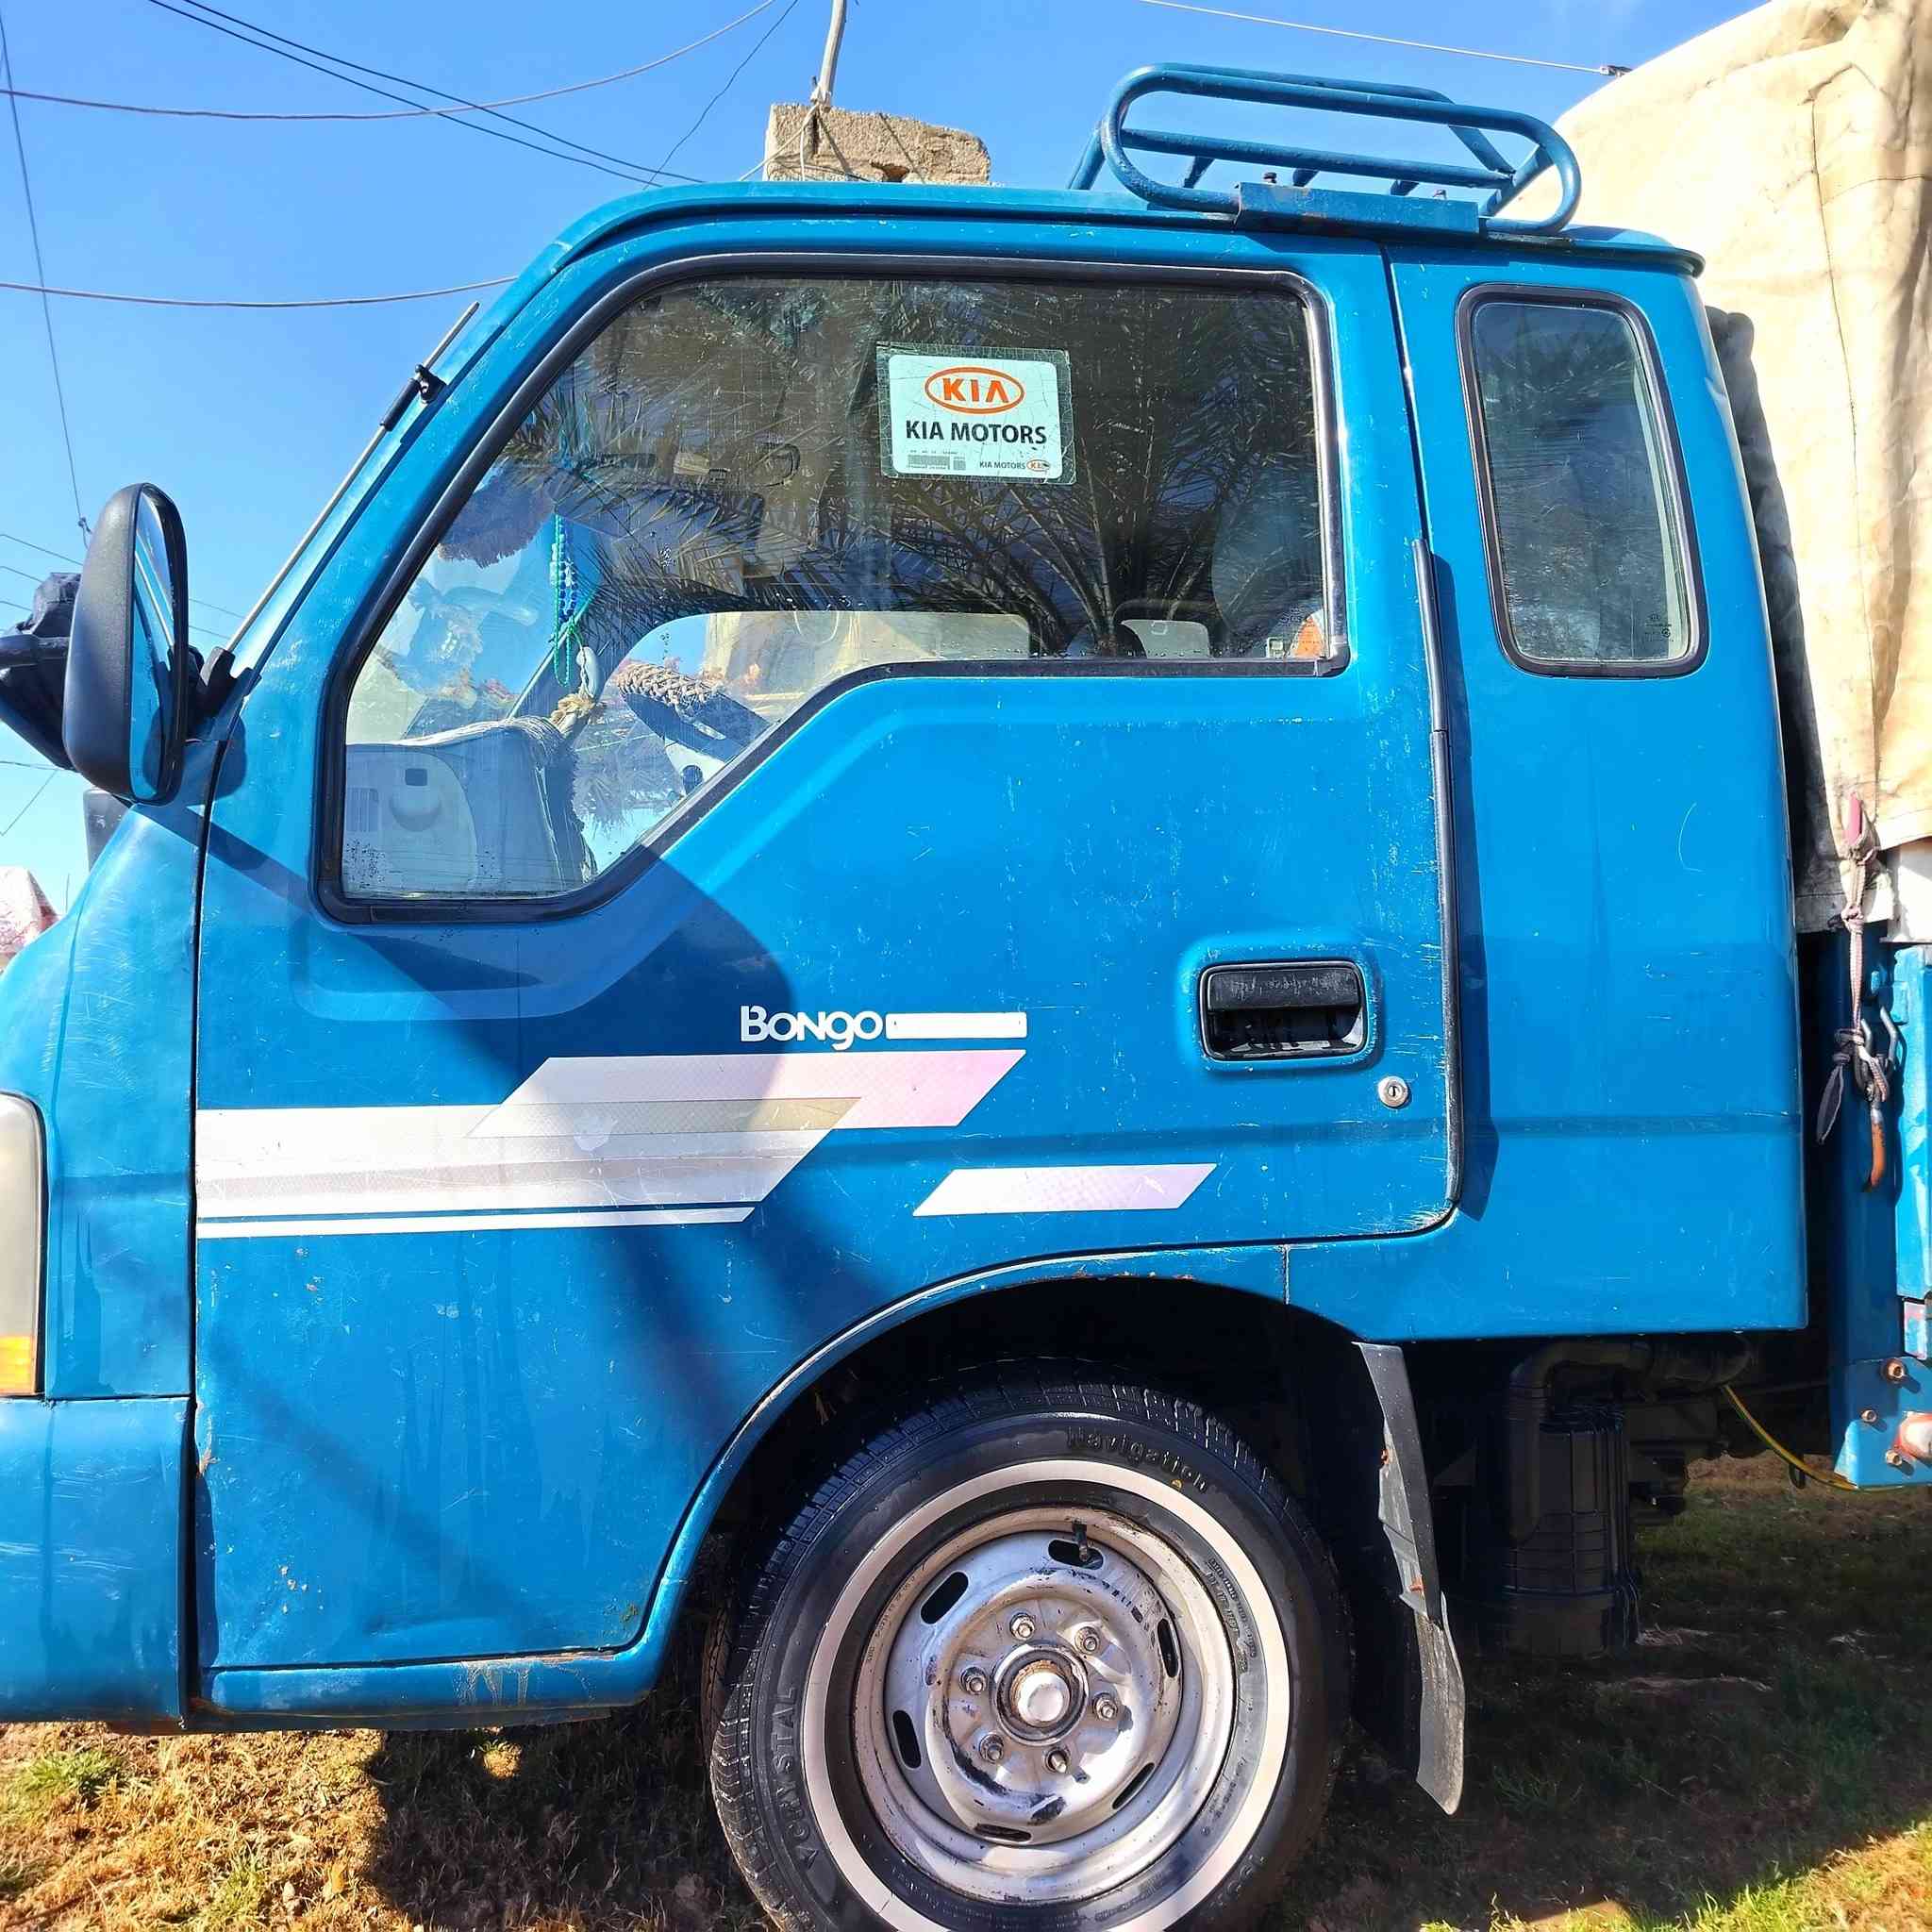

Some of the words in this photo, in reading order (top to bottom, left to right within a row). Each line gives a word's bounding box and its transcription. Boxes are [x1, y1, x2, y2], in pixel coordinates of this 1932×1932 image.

[942, 378, 1008, 403] KIA
[907, 421, 943, 440] KIA
[952, 423, 1047, 444] MOTORS
[979, 460, 992, 469] KIA
[993, 461, 1026, 470] MOTORS
